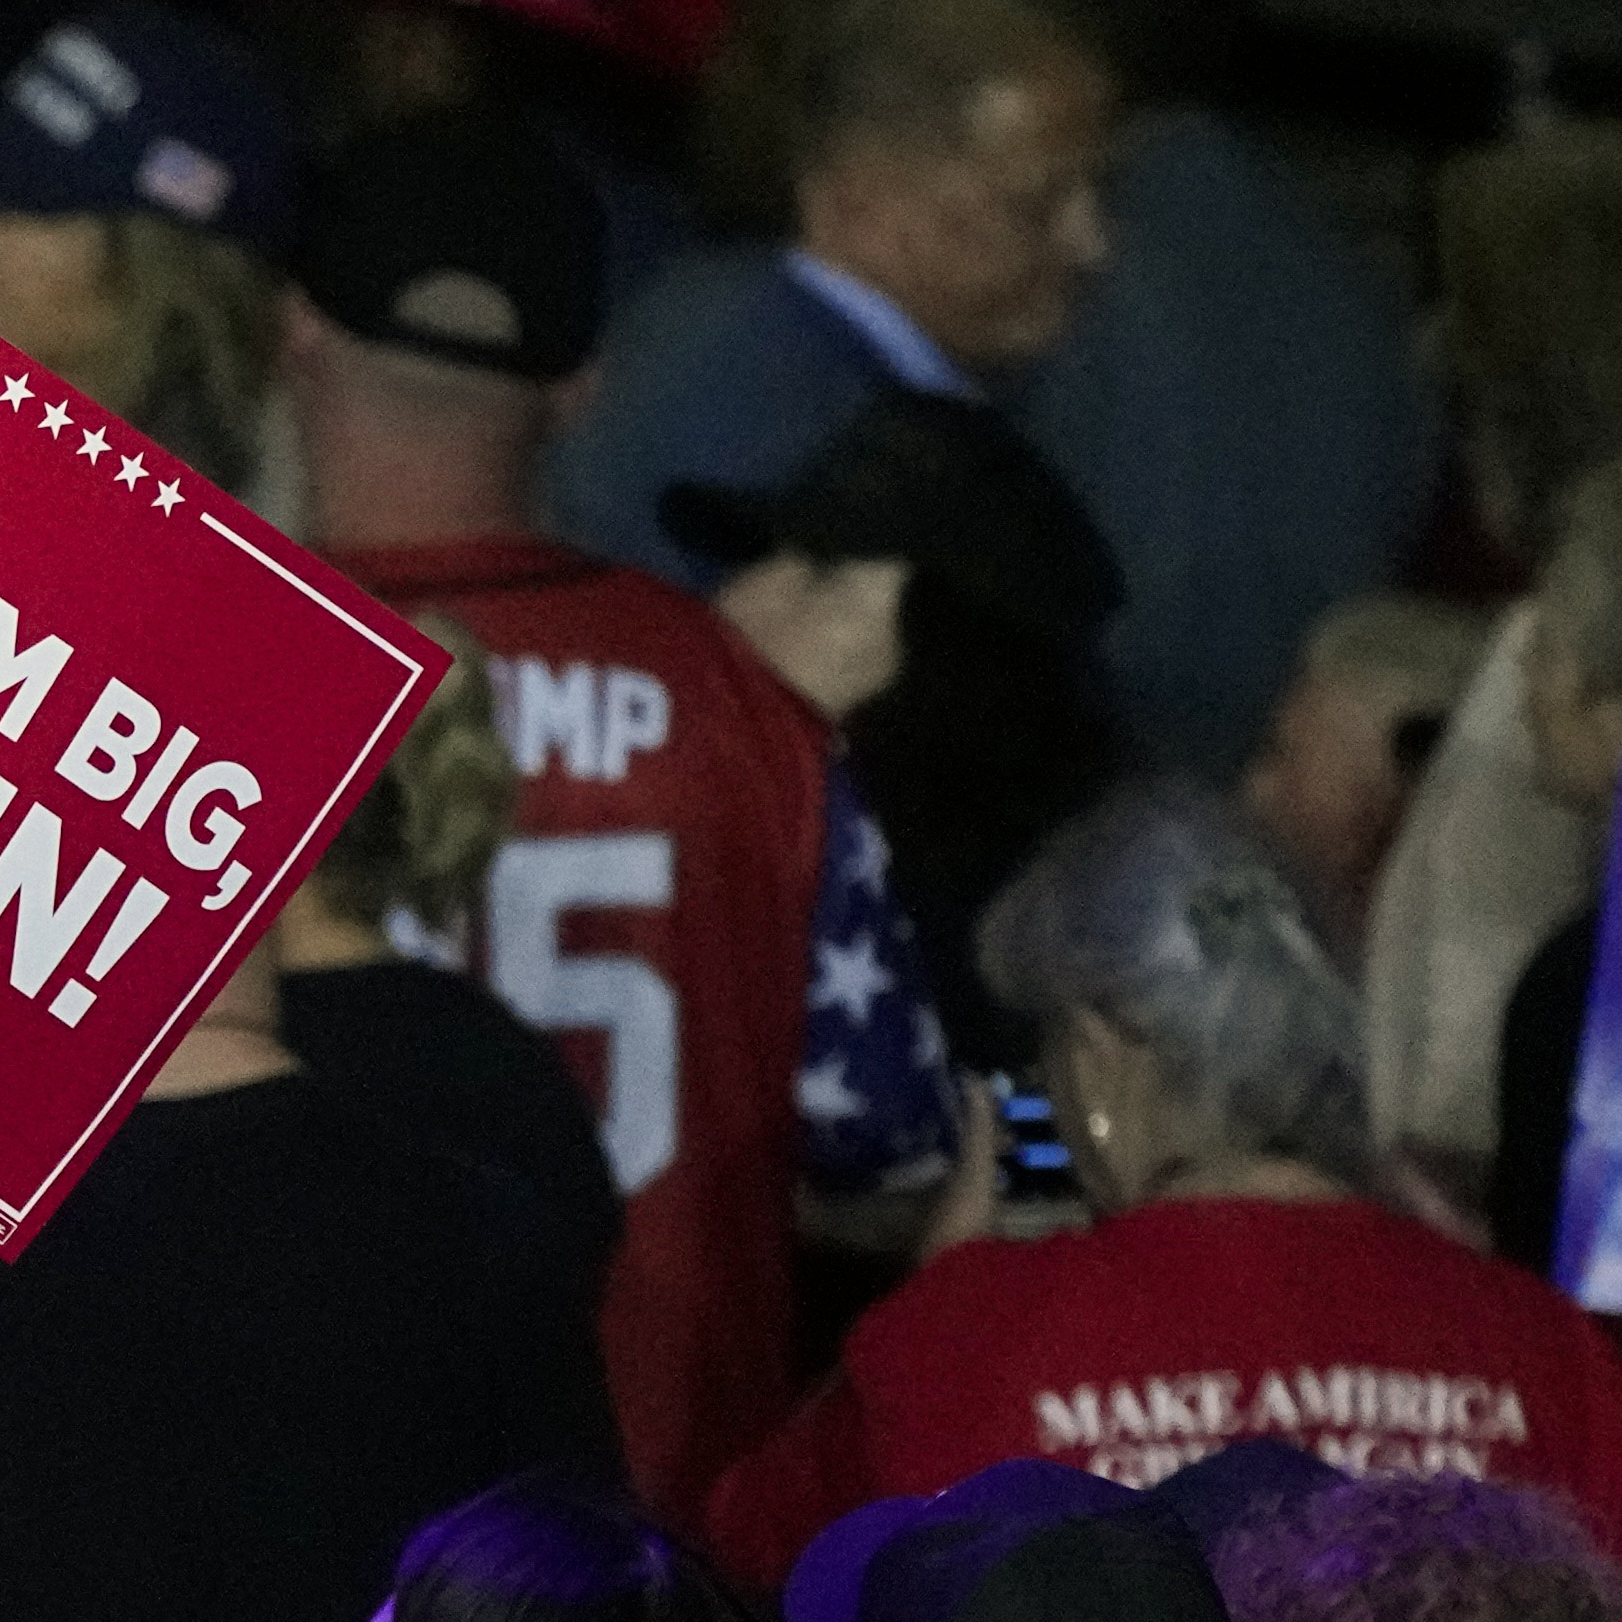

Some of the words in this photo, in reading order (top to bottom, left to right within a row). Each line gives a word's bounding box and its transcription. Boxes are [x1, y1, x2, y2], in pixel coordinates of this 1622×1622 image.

[55, 677, 261, 910] BIG,
[1035, 1368, 1243, 1452] MAKE
[1248, 1362, 1528, 1446] AMERICA
